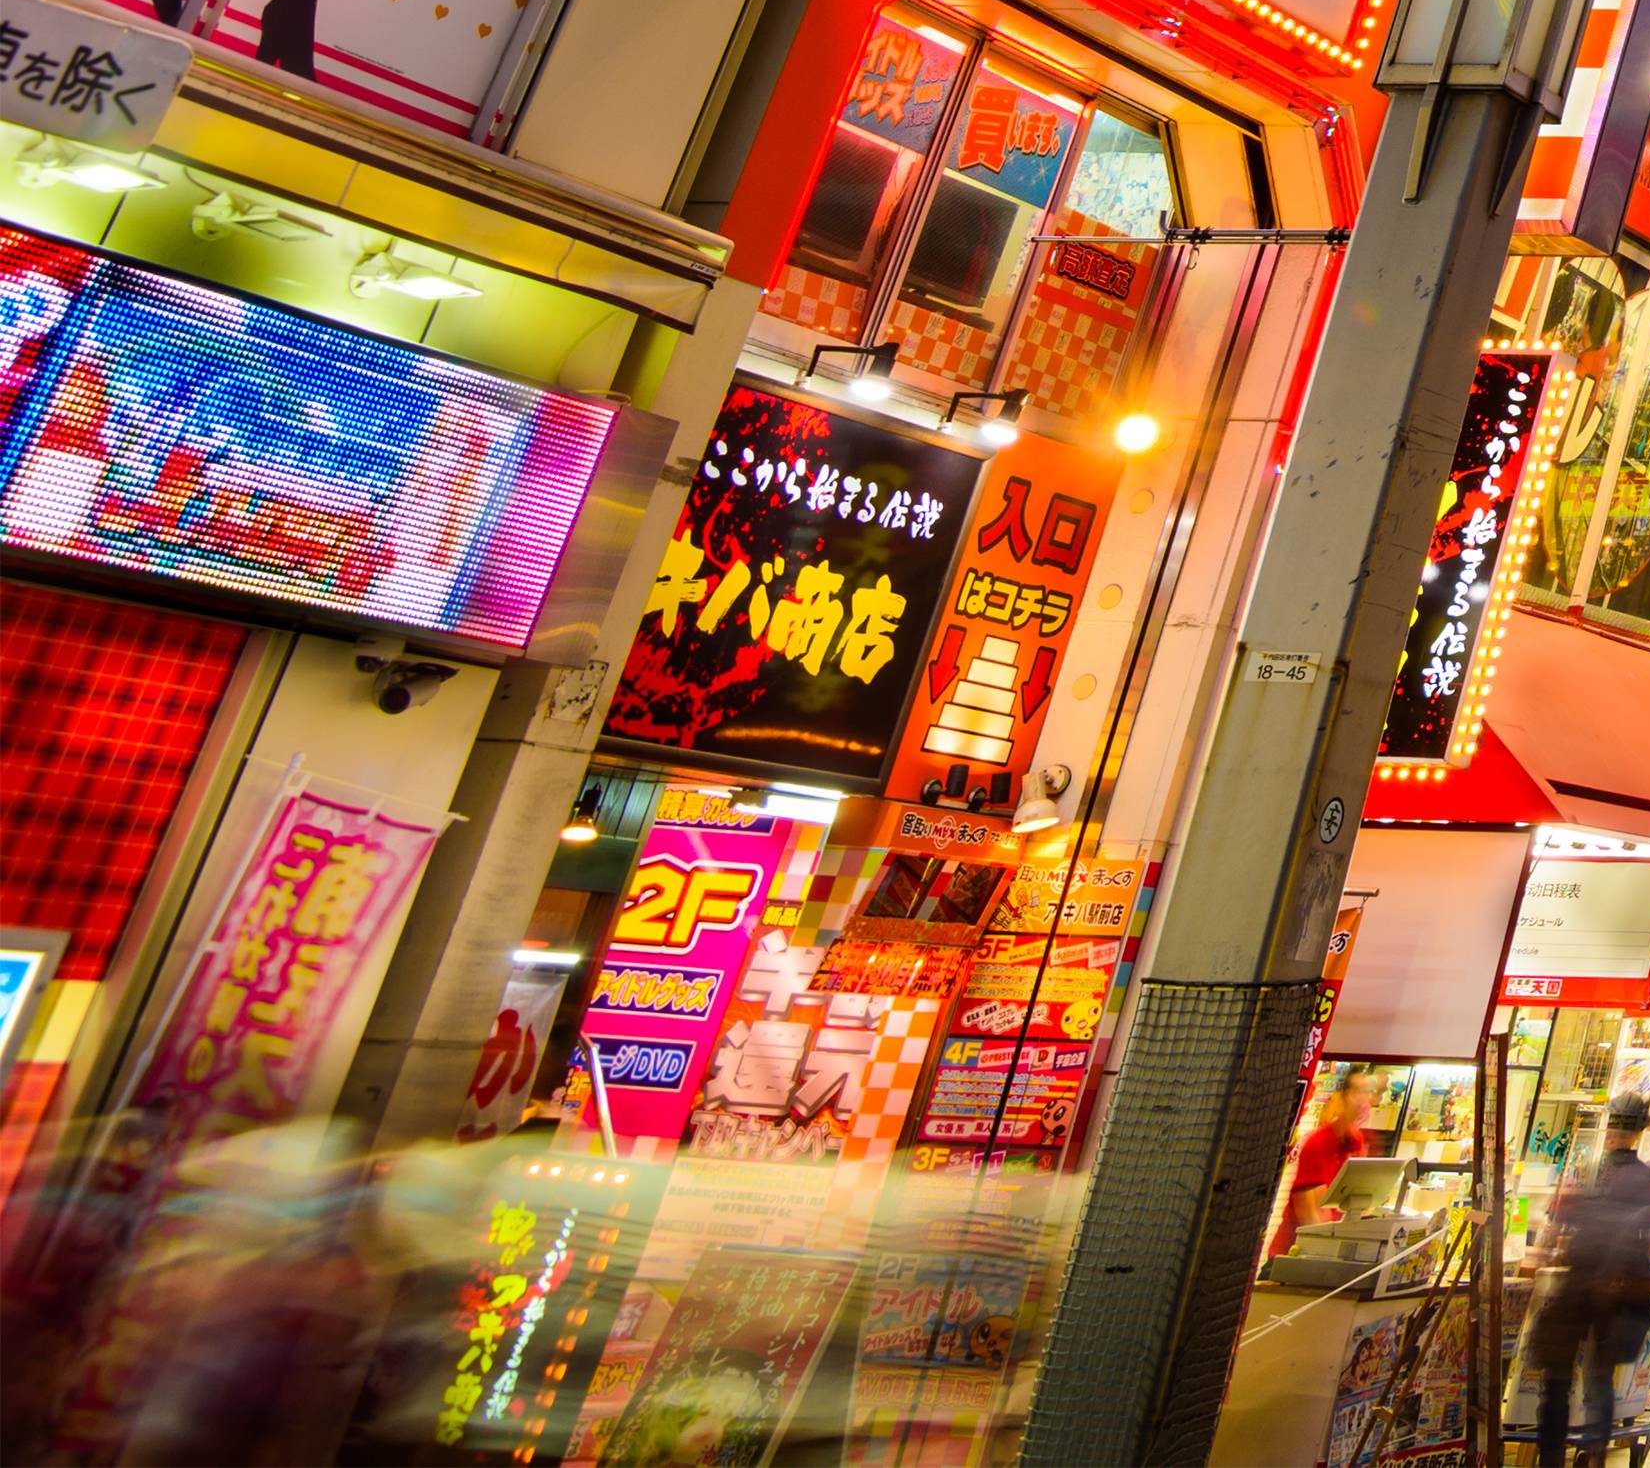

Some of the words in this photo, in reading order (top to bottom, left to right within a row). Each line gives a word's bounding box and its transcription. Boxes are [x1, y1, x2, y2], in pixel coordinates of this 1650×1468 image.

[977, 476, 1097, 576] 入口
[956, 568, 1074, 634] はコチラ
[621, 859, 761, 948] 2F
